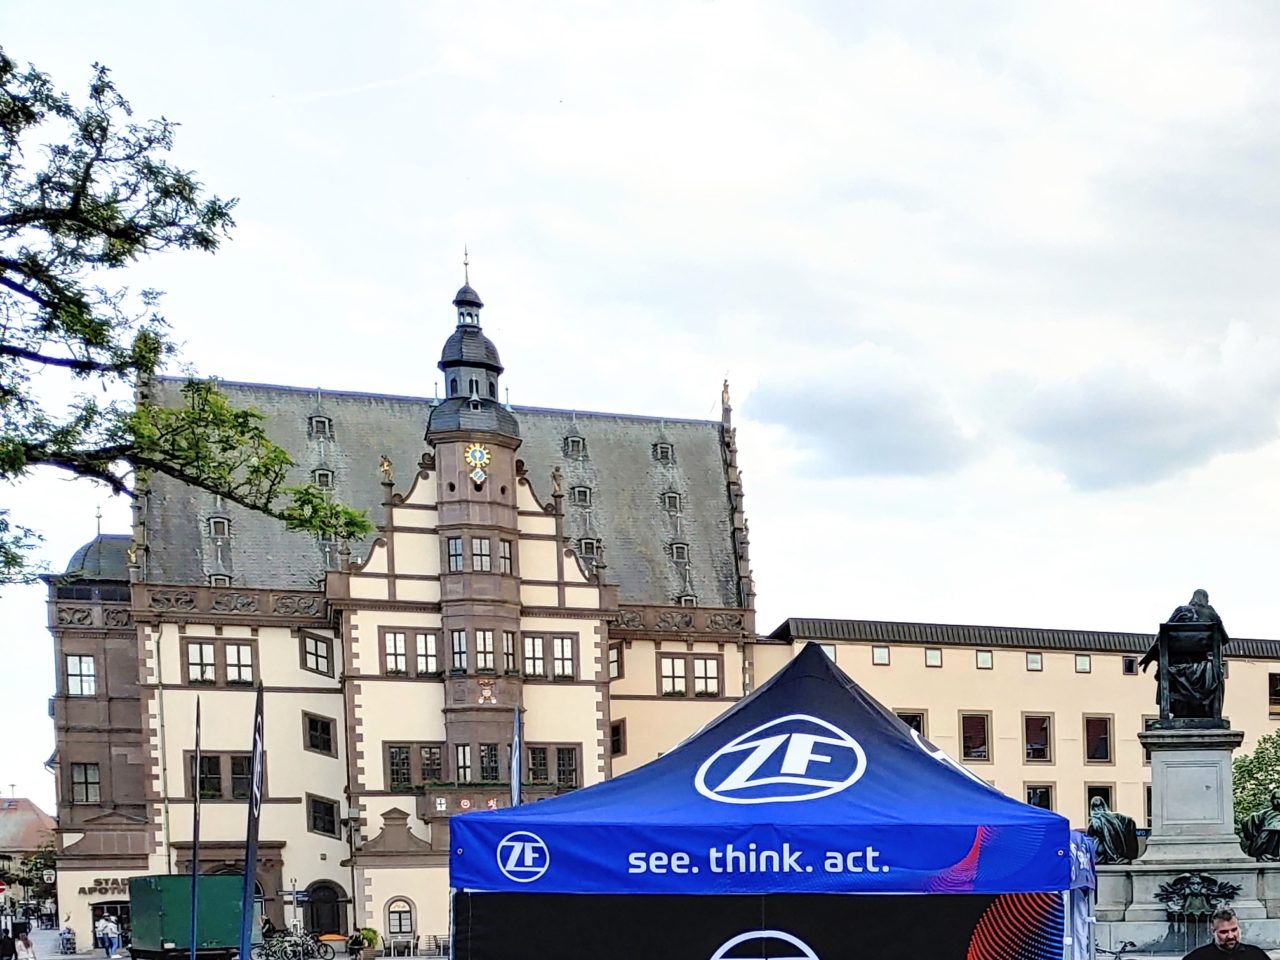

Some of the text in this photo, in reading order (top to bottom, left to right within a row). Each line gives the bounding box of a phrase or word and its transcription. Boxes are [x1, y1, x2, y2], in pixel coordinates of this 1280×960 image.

[712, 732, 854, 793] ZF
[500, 841, 547, 872] ZF
[628, 843, 890, 874] see. think. act.
